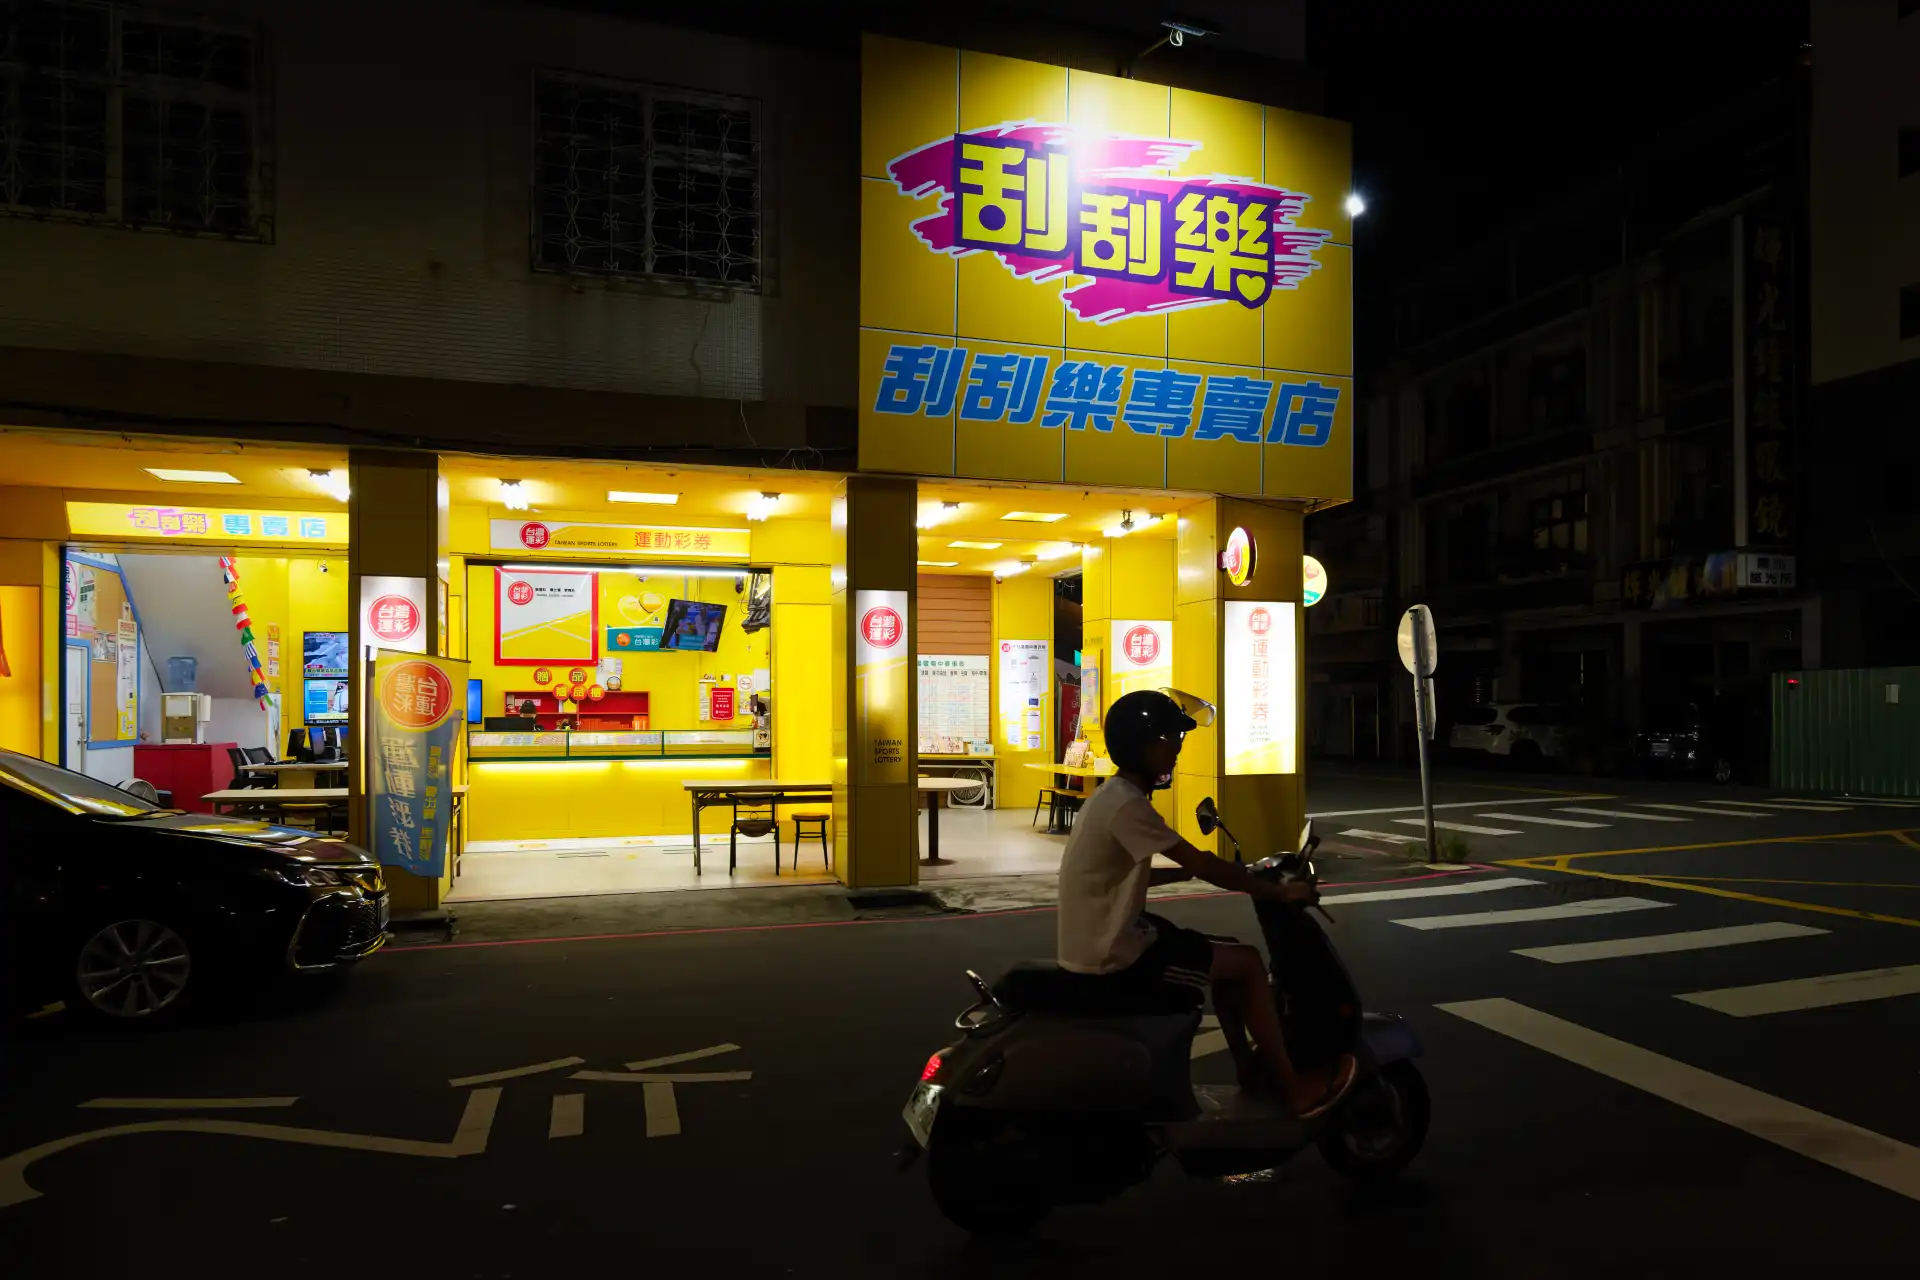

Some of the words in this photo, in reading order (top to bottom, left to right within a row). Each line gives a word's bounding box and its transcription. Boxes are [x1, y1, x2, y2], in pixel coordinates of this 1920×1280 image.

[957, 141, 1271, 305] 刮刮樂
[873, 343, 1342, 448] 刮刮樂專賣店
[132, 507, 208, 535] 刮刮樂
[222, 513, 327, 538] 專賣店
[525, 528, 544, 536] 台灣
[525, 535, 545, 544] 運彩
[634, 531, 712, 550] 運動彩券
[378, 605, 410, 619] 台灣
[378, 618, 410, 633] 運彩
[869, 615, 895, 628] 台灣
[869, 627, 895, 641] 運彩
[1131, 633, 1154, 646] 台灣
[1131, 645, 1154, 658] 運彩
[572, 671, 584, 682] 品
[1252, 638, 1269, 722] 運動彩券
[874, 747, 900, 755] SPORTS
[874, 756, 903, 764] LOTTERY
